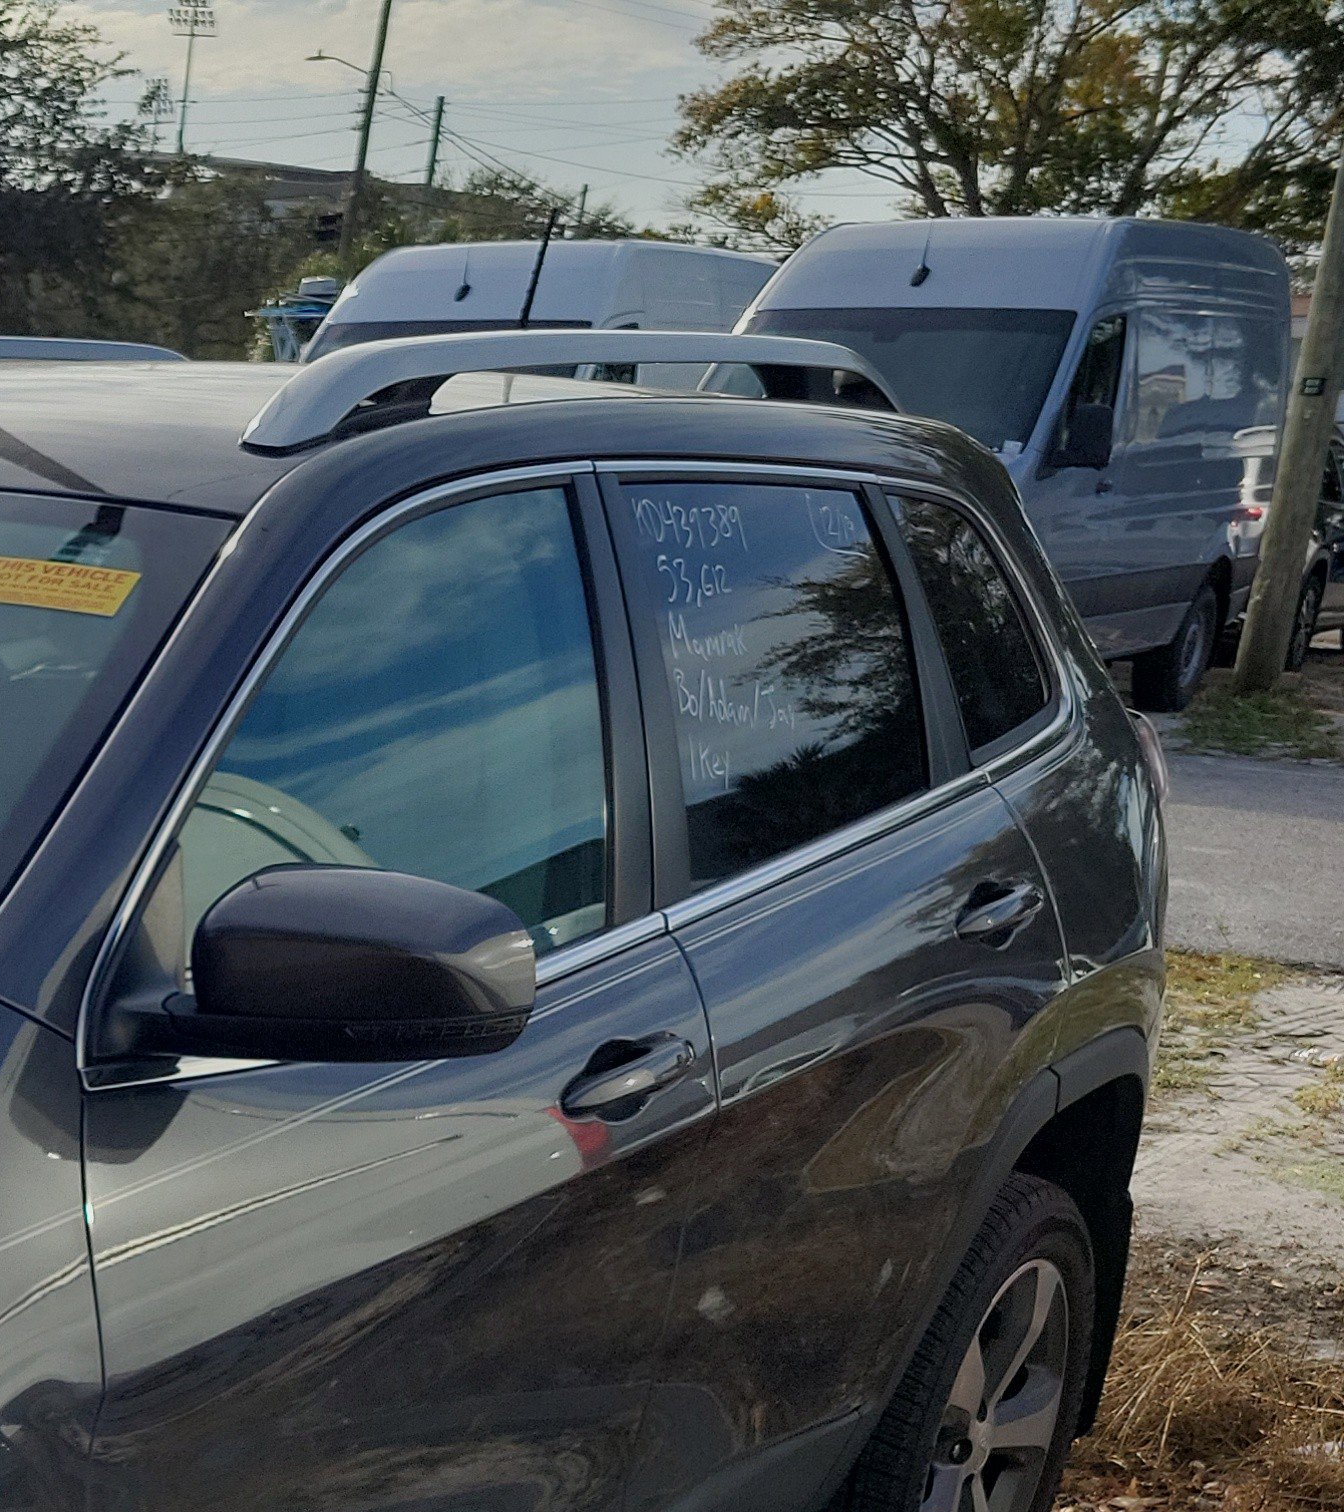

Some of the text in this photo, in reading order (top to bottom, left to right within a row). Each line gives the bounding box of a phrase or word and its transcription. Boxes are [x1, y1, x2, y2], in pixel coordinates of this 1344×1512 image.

[26, 574, 64, 587] FOR
[69, 579, 117, 592] SALE
[42, 563, 130, 585] VEHICLE
